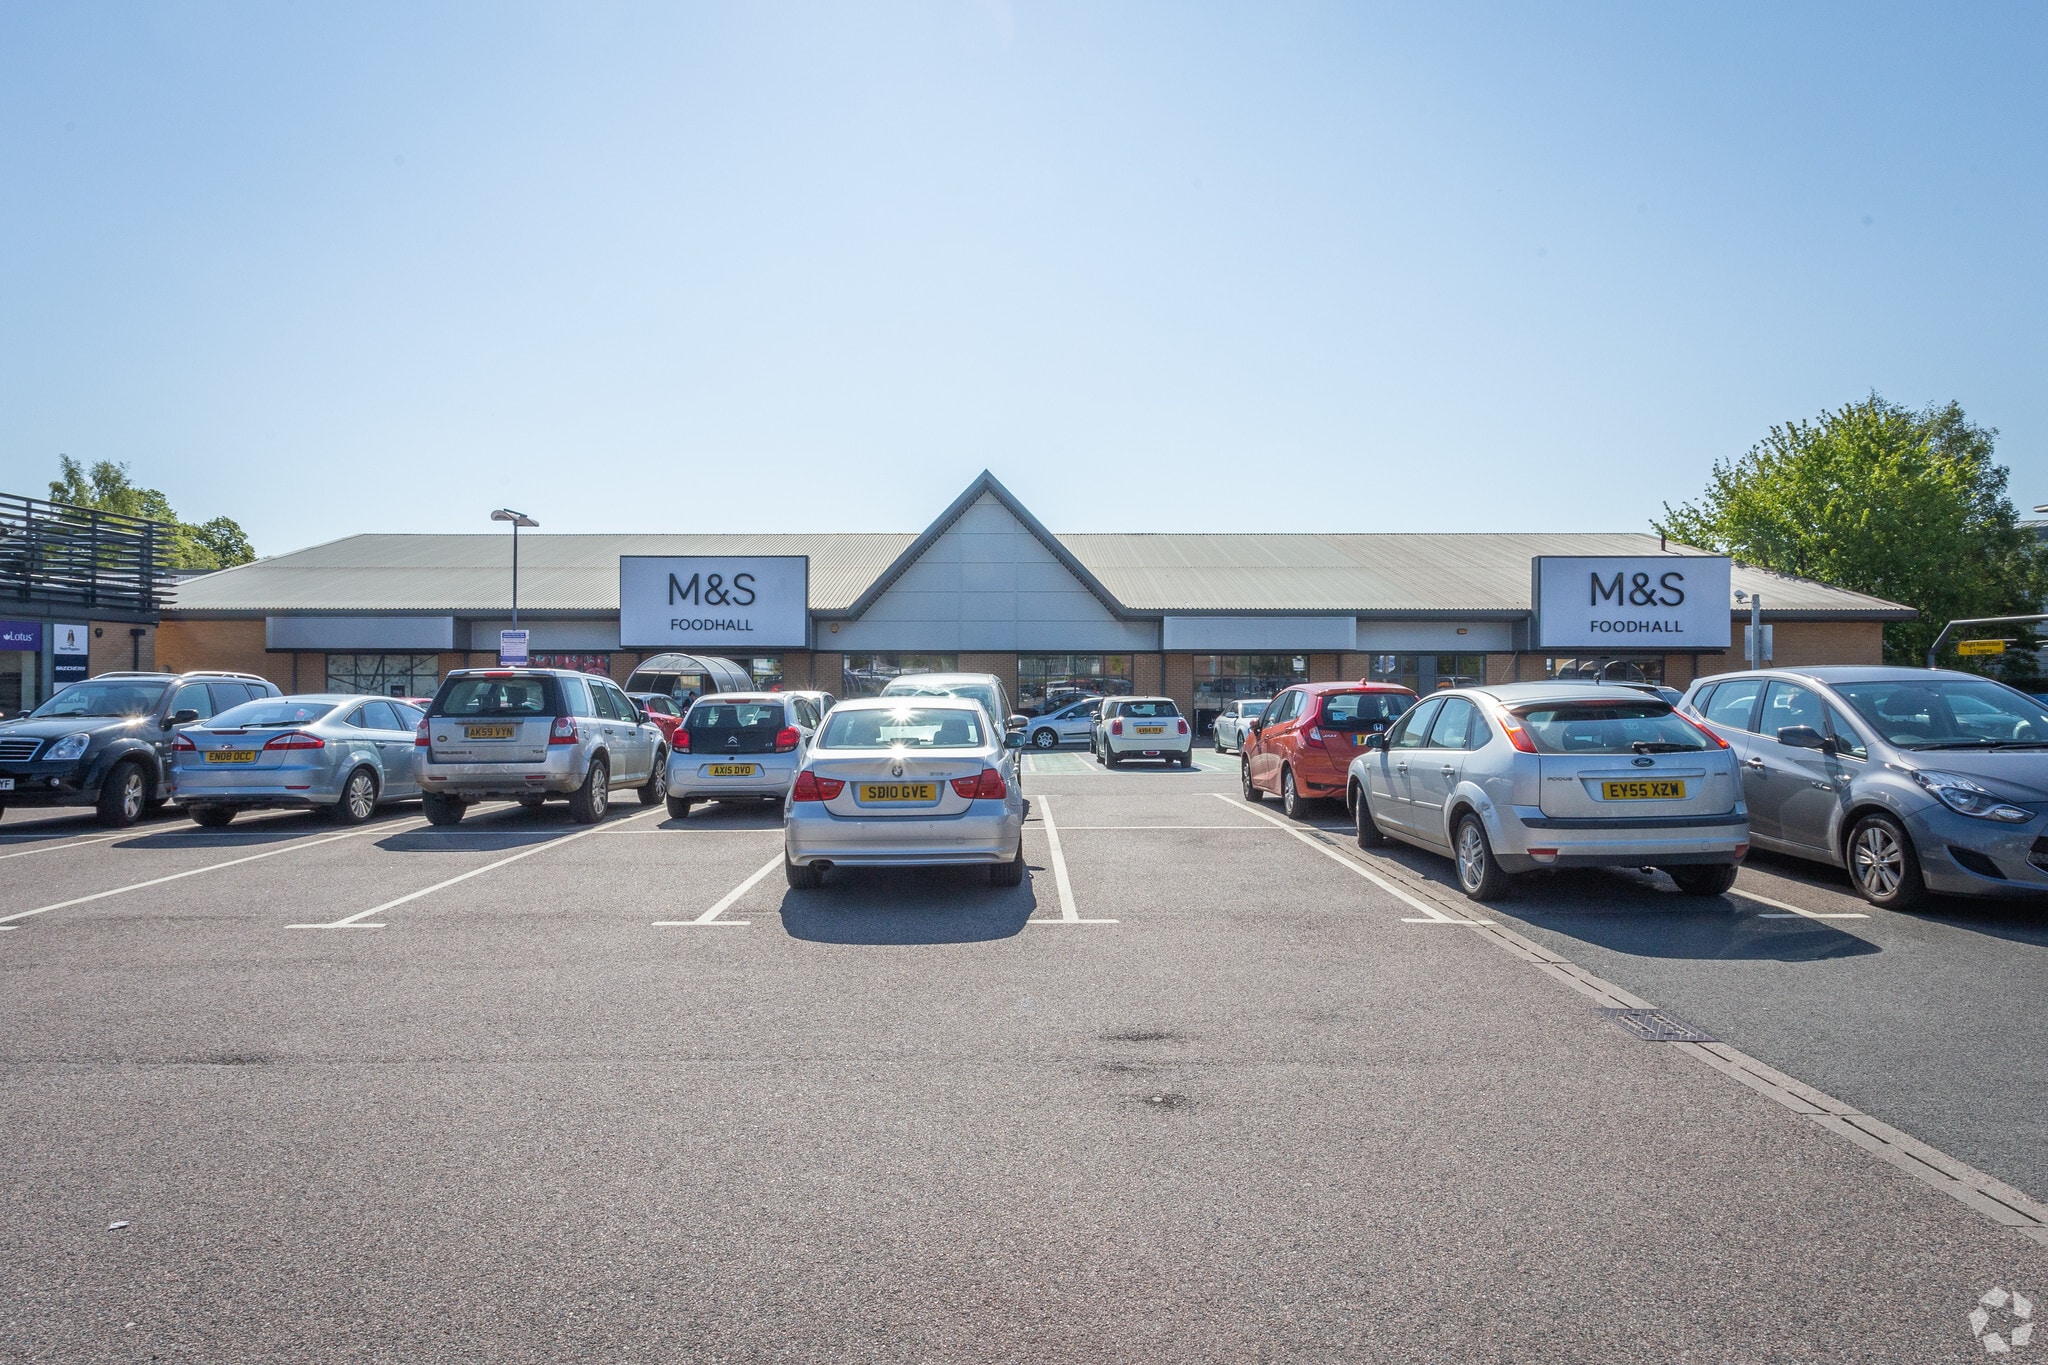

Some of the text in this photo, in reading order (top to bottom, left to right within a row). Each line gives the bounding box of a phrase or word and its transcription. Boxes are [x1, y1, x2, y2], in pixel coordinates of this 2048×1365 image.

[668, 573, 755, 606] M&S
[1590, 572, 1685, 607] M&S
[671, 619, 753, 631] FOODHALL
[1590, 620, 1684, 633] FOODHALL
[469, 727, 513, 736] AK59 VYN
[209, 752, 252, 761] EN08 OCC
[714, 766, 751, 774] AX15 DVO
[868, 786, 928, 798] SD10 GVE
[1610, 783, 1679, 797] EY55 XZW
